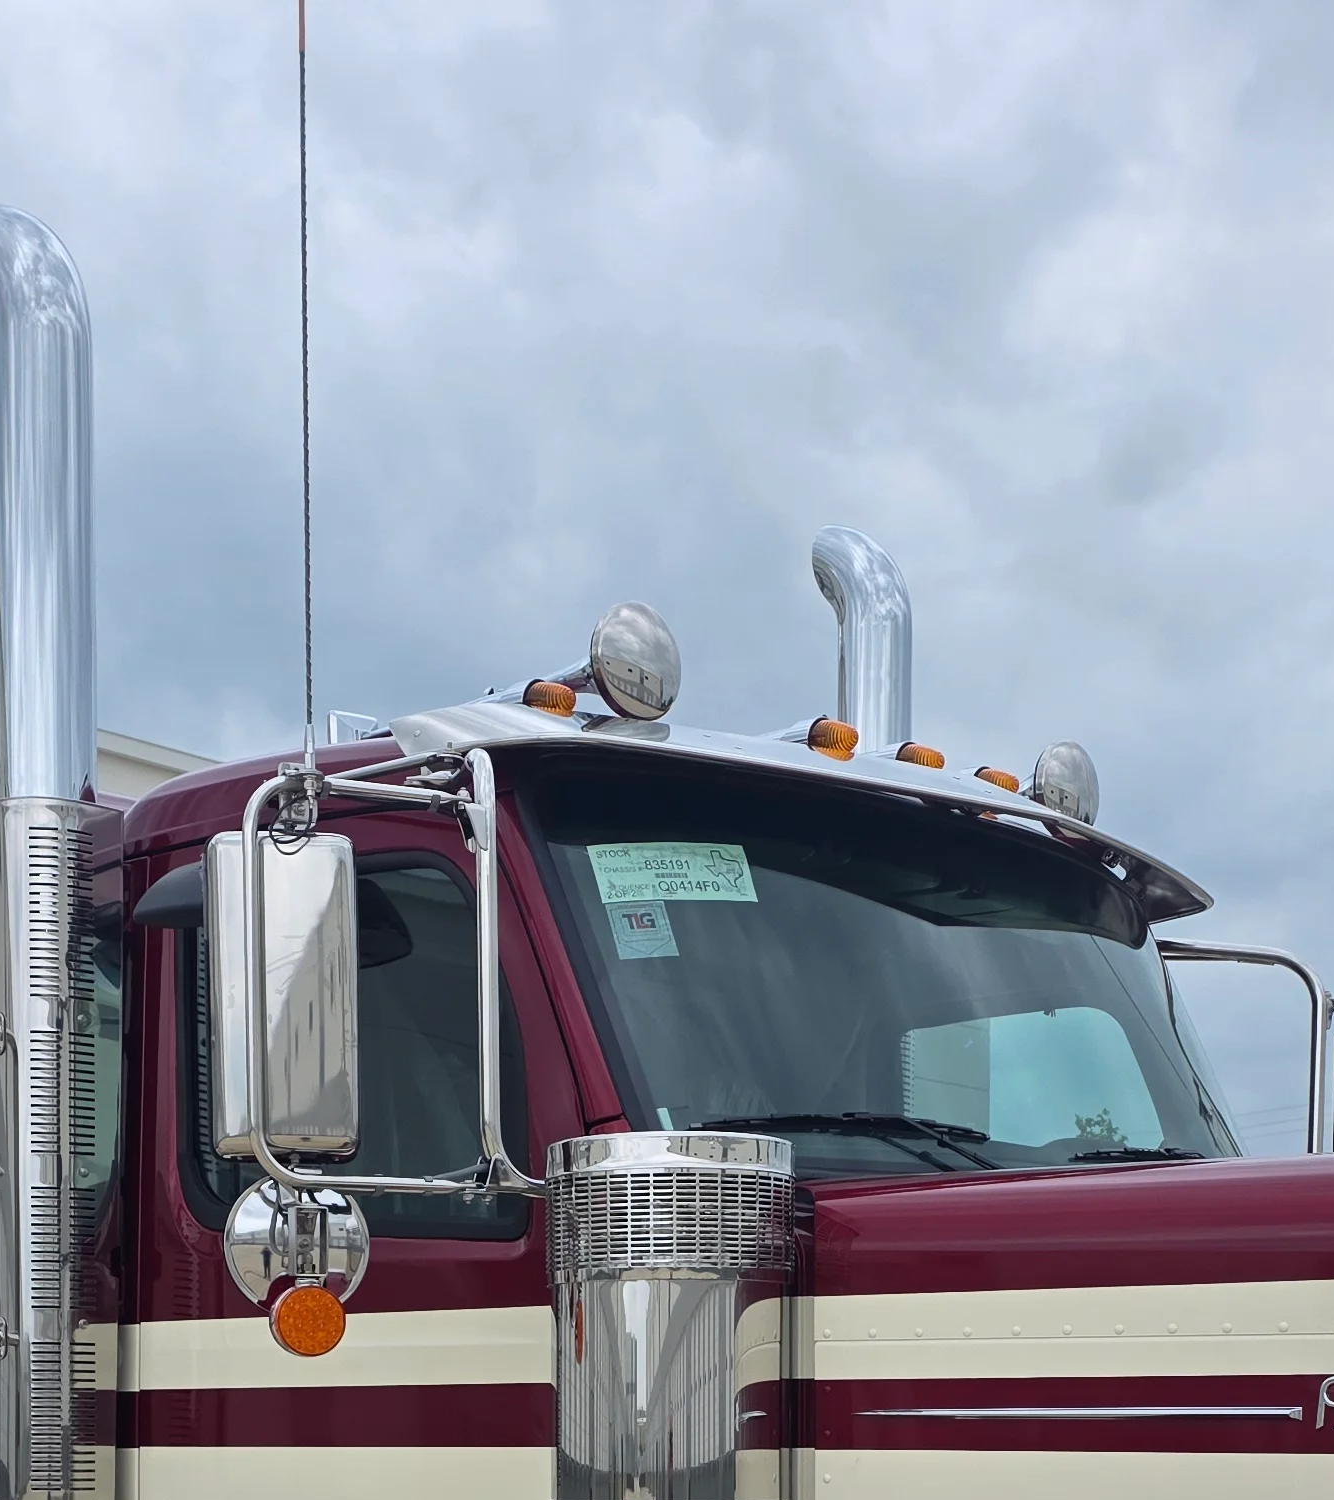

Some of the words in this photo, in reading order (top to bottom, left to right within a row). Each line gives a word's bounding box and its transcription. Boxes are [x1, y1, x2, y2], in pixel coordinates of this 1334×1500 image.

[595, 849, 631, 859] STOCK
[603, 866, 637, 874] CHASSIS
[644, 859, 691, 871] 835191
[615, 890, 628, 899] OF
[621, 912, 657, 930] TLG
